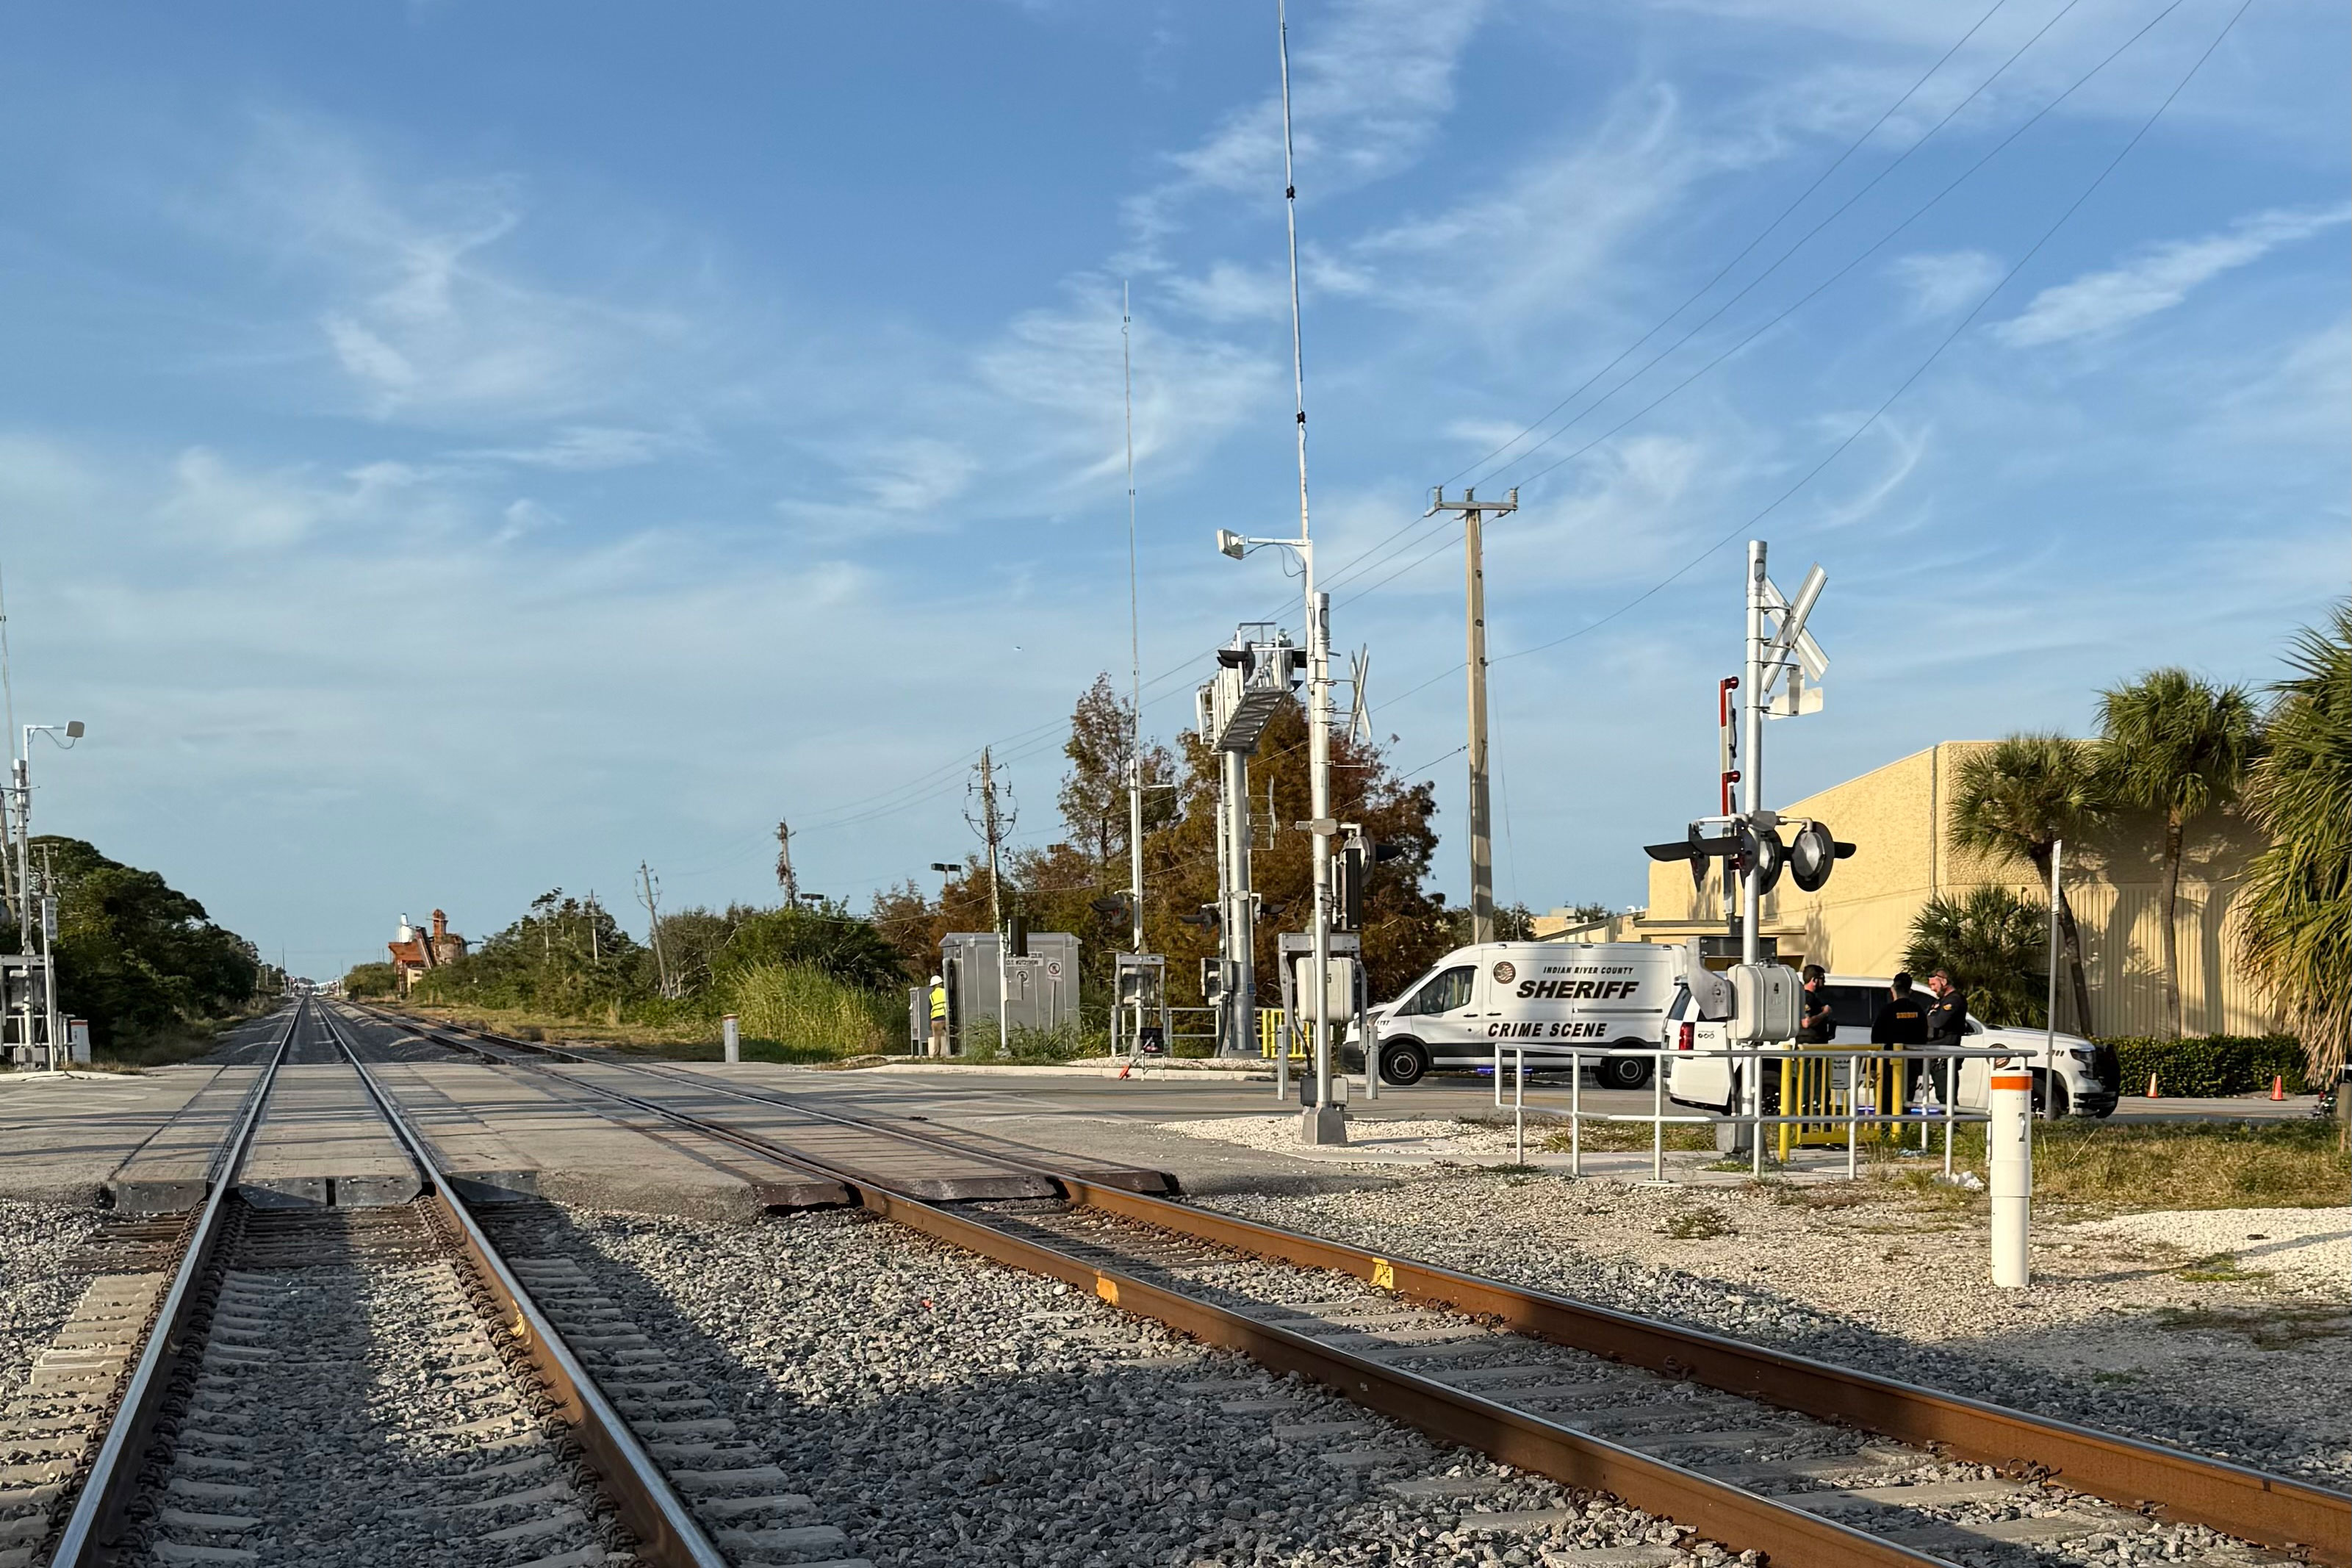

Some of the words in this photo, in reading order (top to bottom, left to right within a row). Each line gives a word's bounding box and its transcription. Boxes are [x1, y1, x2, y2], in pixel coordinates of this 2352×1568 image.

[1601, 966, 1634, 974] COUNTY
[1517, 980, 1639, 999] SHERIFF
[1774, 982, 1779, 994] 4
[1488, 1023, 1543, 1037] CRIME
[1549, 1023, 1607, 1037] SCENE
